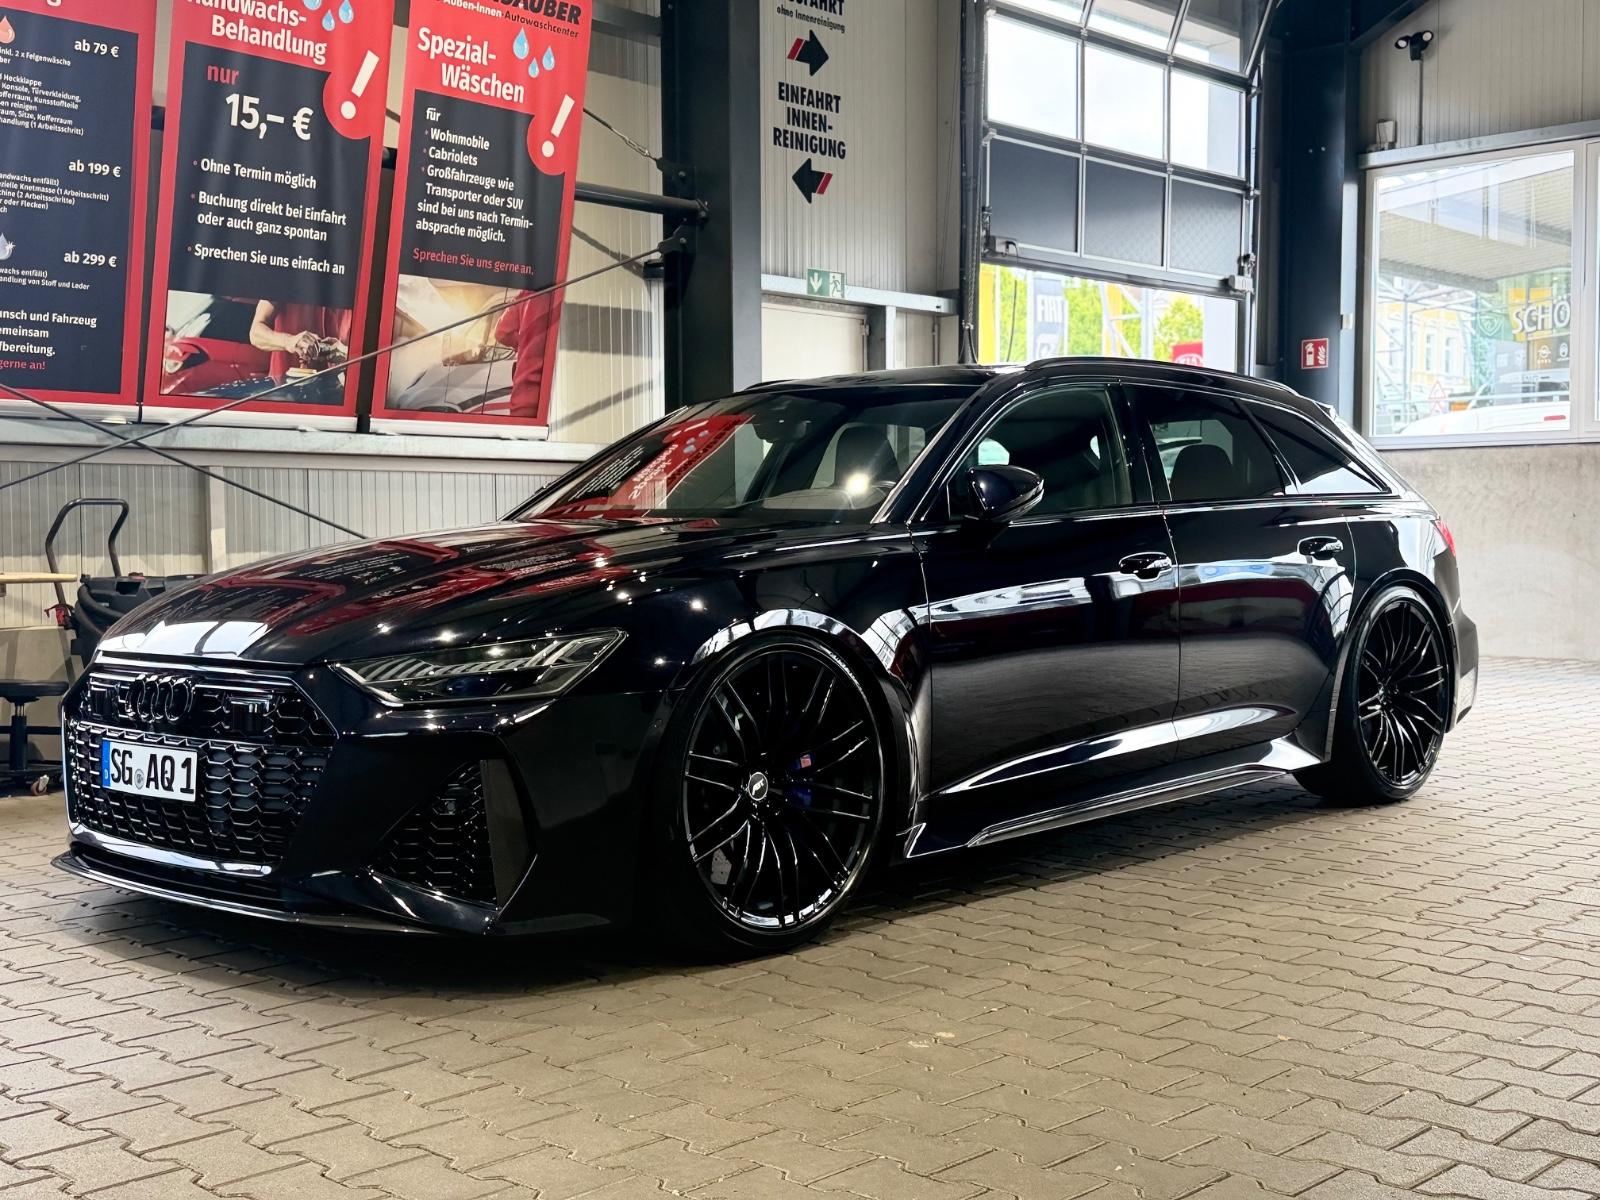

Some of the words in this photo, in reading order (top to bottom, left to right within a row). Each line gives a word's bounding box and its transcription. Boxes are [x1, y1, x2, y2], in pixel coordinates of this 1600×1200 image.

[187, 0, 307, 27] andwachs-
[776, 4, 794, 18] ohne
[795, 9, 846, 34] Innenreinigung
[74, 39, 91, 53] ab
[93, 42, 108, 56] 79
[110, 46, 120, 58] €
[211, 14, 327, 66] Behandlung
[417, 26, 496, 66] Spezial-
[15, 50, 20, 58] 2
[207, 64, 240, 86] nur
[441, 63, 525, 104] Wäschen
[778, 81, 841, 114] EINFAHRT
[36, 113, 73, 126] Kofferraum
[292, 107, 314, 141] €
[426, 107, 441, 122] für
[786, 106, 833, 133] INNEN-
[430, 127, 490, 151] Wohnmobile
[773, 126, 847, 160] REINIGUNG
[68, 159, 85, 173] ab
[87, 162, 110, 176] 199
[112, 166, 121, 178] €
[429, 146, 478, 167] Cabriolets
[0, 180, 19, 190] zielle
[200, 158, 231, 175] Ohne
[233, 163, 272, 181] Termin
[274, 170, 317, 190] möglich
[427, 164, 496, 190] Großfahrzeuge
[498, 178, 515, 191] wie
[198, 191, 248, 213] Buchung
[250, 198, 283, 216] direkt
[286, 203, 303, 219] bei
[304, 208, 347, 226] Einfahrt
[426, 182, 481, 204] Transporter
[483, 192, 504, 207] oder
[506, 197, 524, 211] SUV
[197, 212, 225, 227] oder
[226, 215, 253, 231] auch
[255, 220, 282, 236] ganz
[283, 225, 327, 242] spontan
[417, 200, 439, 214] sind
[440, 205, 456, 218] bei
[457, 208, 475, 220] uns
[476, 210, 498, 224] nach
[500, 213, 534, 230] Termin-
[415, 218, 466, 239] absprache
[467, 227, 506, 243] möglich.
[63, 250, 80, 264] ab
[82, 252, 106, 266] 299
[108, 256, 118, 268] €
[194, 243, 248, 263] Sprechen
[250, 249, 267, 265] Sie
[269, 254, 289, 268] uns
[291, 256, 331, 273] einfach
[332, 263, 345, 275] an
[413, 247, 458, 266] Sprechen
[459, 253, 475, 267] Sie
[476, 257, 493, 270] uns
[494, 260, 520, 274] gerne
[520, 264, 535, 276] an.
[29, 312, 50, 322] und
[51, 313, 98, 329] Fahrzeug
[29, 360, 46, 371] an!
[111, 748, 133, 786] SG
[145, 753, 175, 792] AQ
[179, 757, 195, 794] 1
